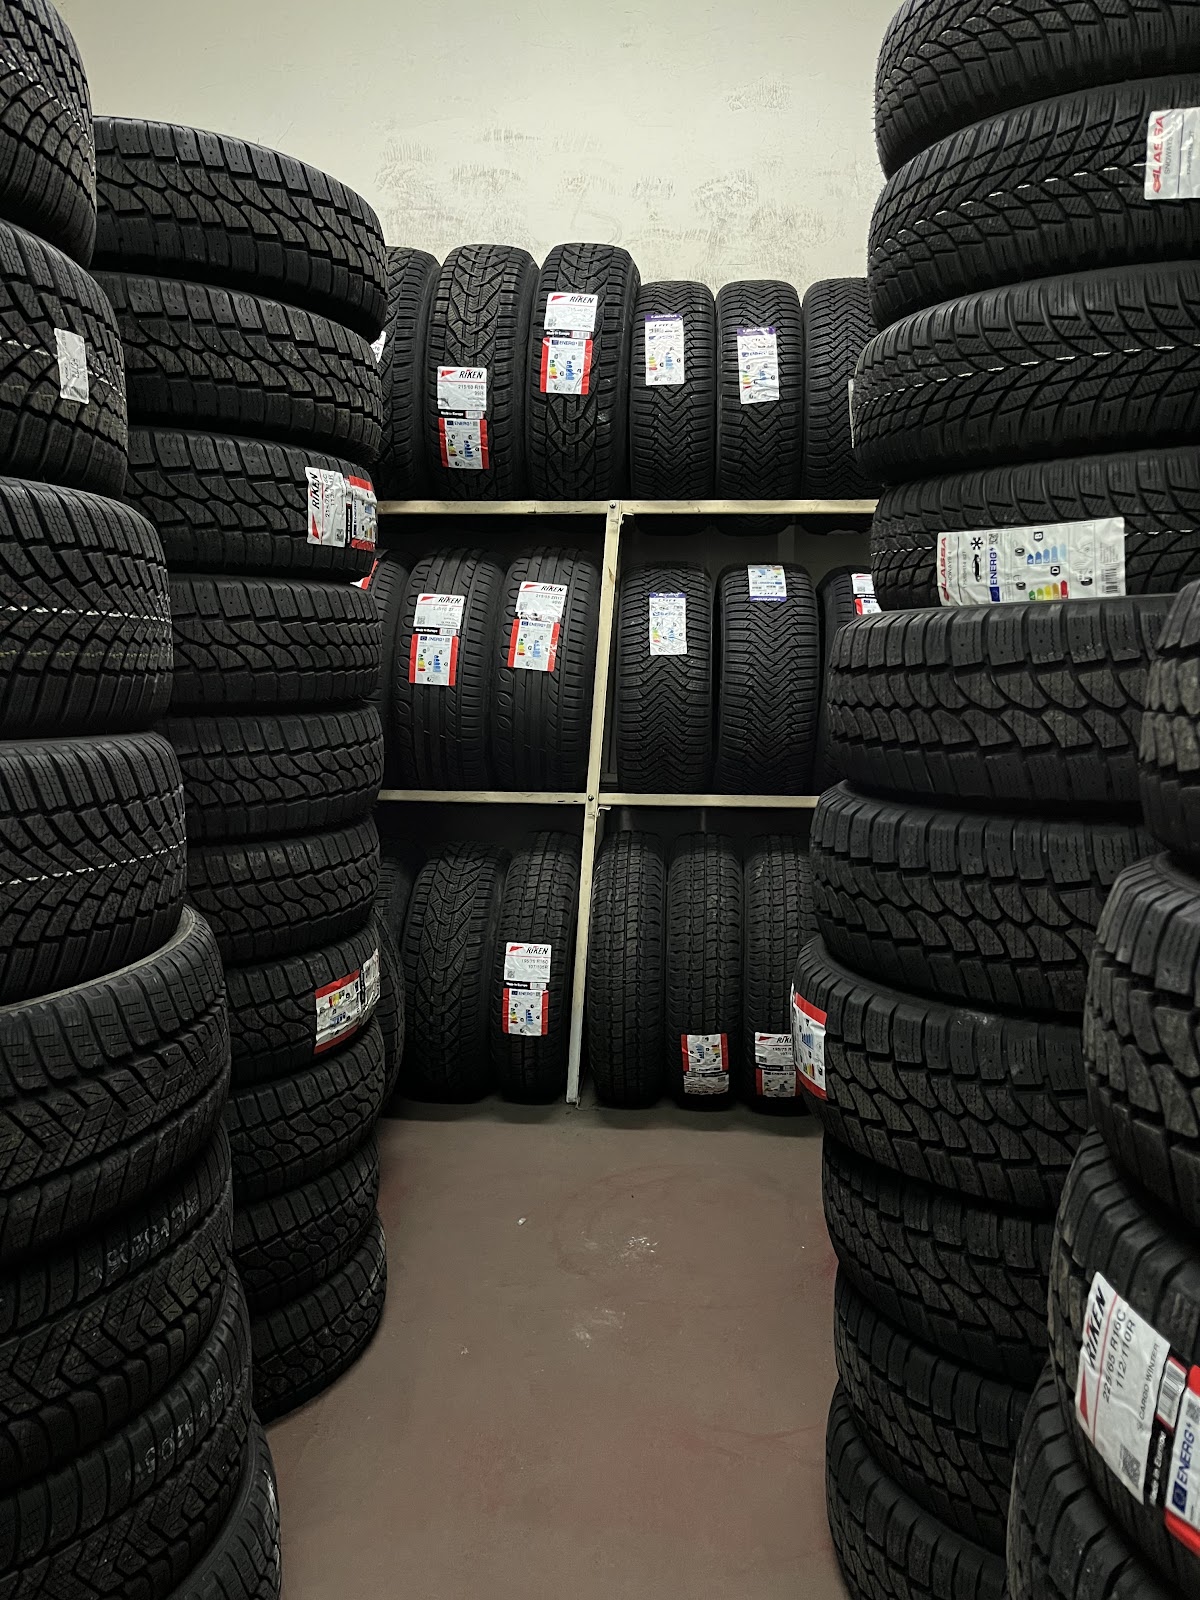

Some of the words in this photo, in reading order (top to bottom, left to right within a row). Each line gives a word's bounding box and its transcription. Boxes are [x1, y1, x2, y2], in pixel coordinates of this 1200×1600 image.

[569, 295, 595, 304] RIKEN
[458, 369, 484, 379] RIKEN
[309, 472, 320, 510] RIKEN
[940, 537, 948, 590] LASSA
[437, 595, 462, 604] RIKEN
[541, 584, 565, 593] RIKEN
[525, 945, 549, 955] RIKEN
[776, 1035, 792, 1043] RIK
[1085, 1284, 1106, 1371] RIKEN
[1102, 1353, 1116, 1404] 225/65
[1110, 1308, 1126, 1351] R16C
[1116, 1319, 1137, 1389] 112/110R
[1145, 1343, 1160, 1382] WINTER
[1140, 1383, 1151, 1421] CARGO
[1177, 1428, 1195, 1485] ENERG
